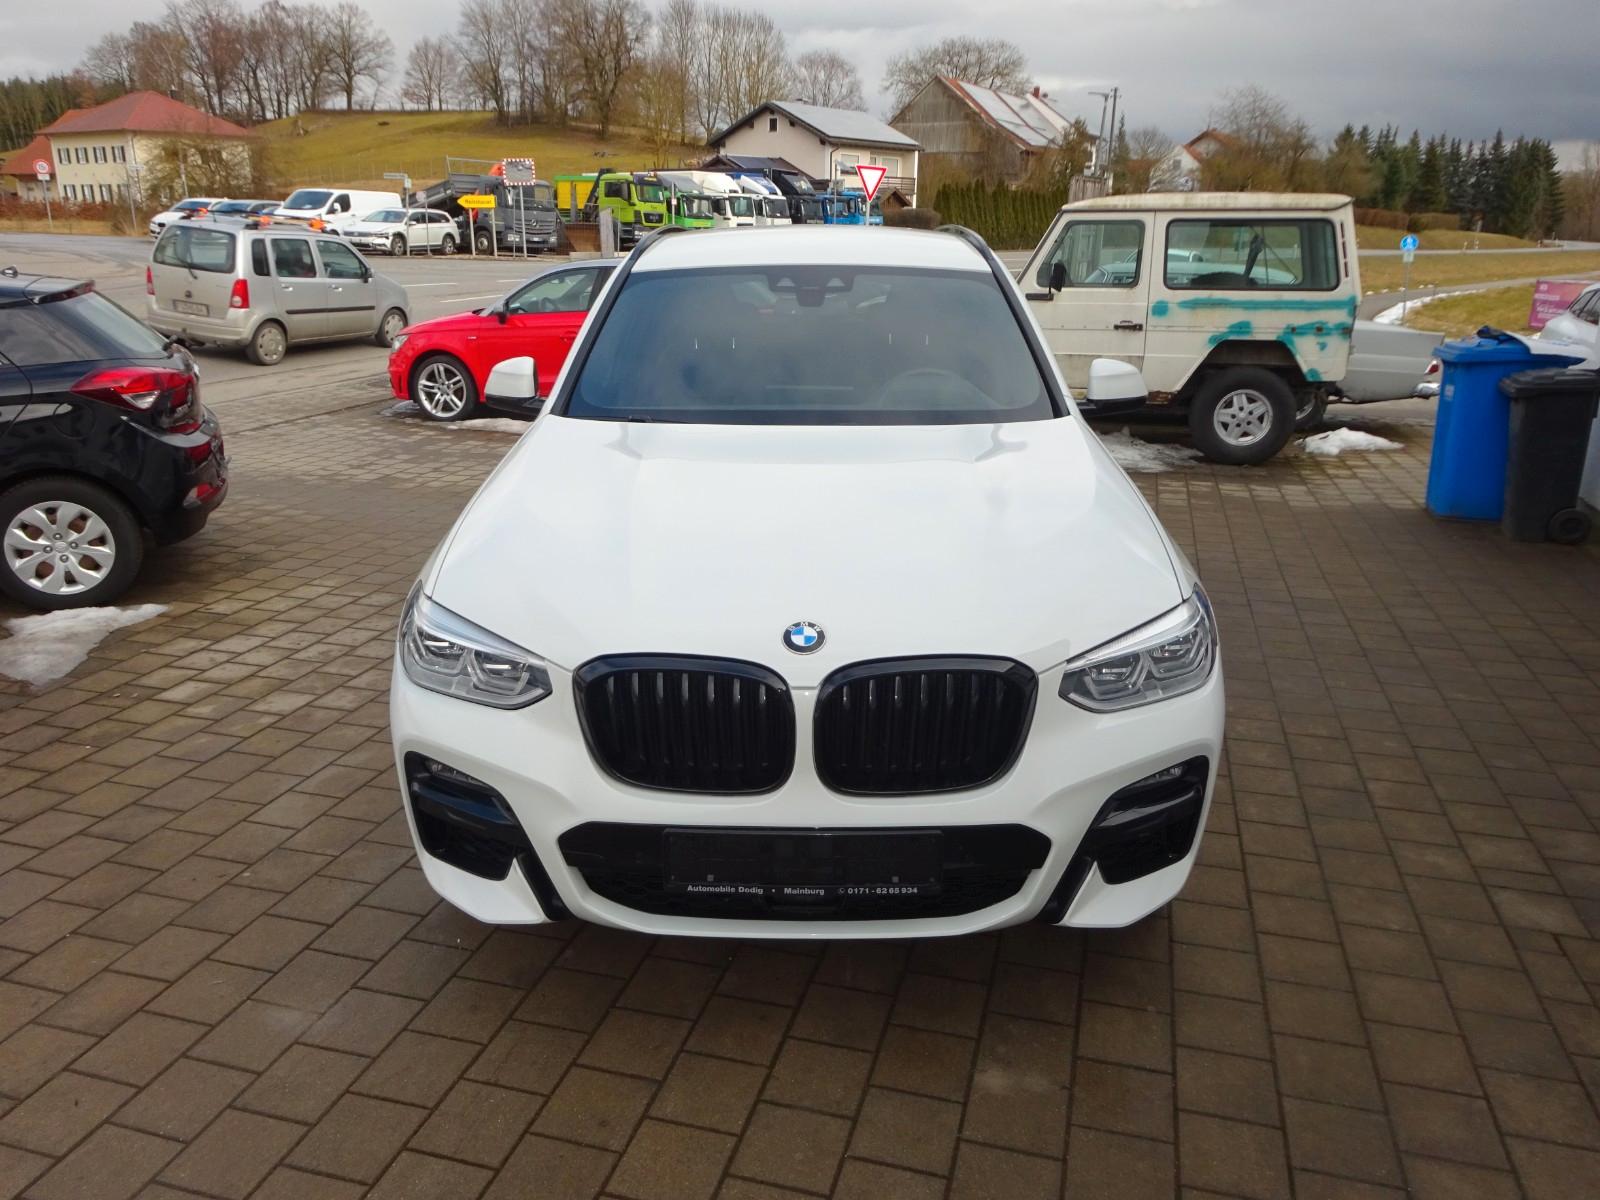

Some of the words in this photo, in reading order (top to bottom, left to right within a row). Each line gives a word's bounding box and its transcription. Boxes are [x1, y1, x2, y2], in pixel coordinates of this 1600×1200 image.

[687, 884, 736, 893] Automobile
[738, 886, 764, 895] Dodig
[784, 887, 825, 896] Mainburg
